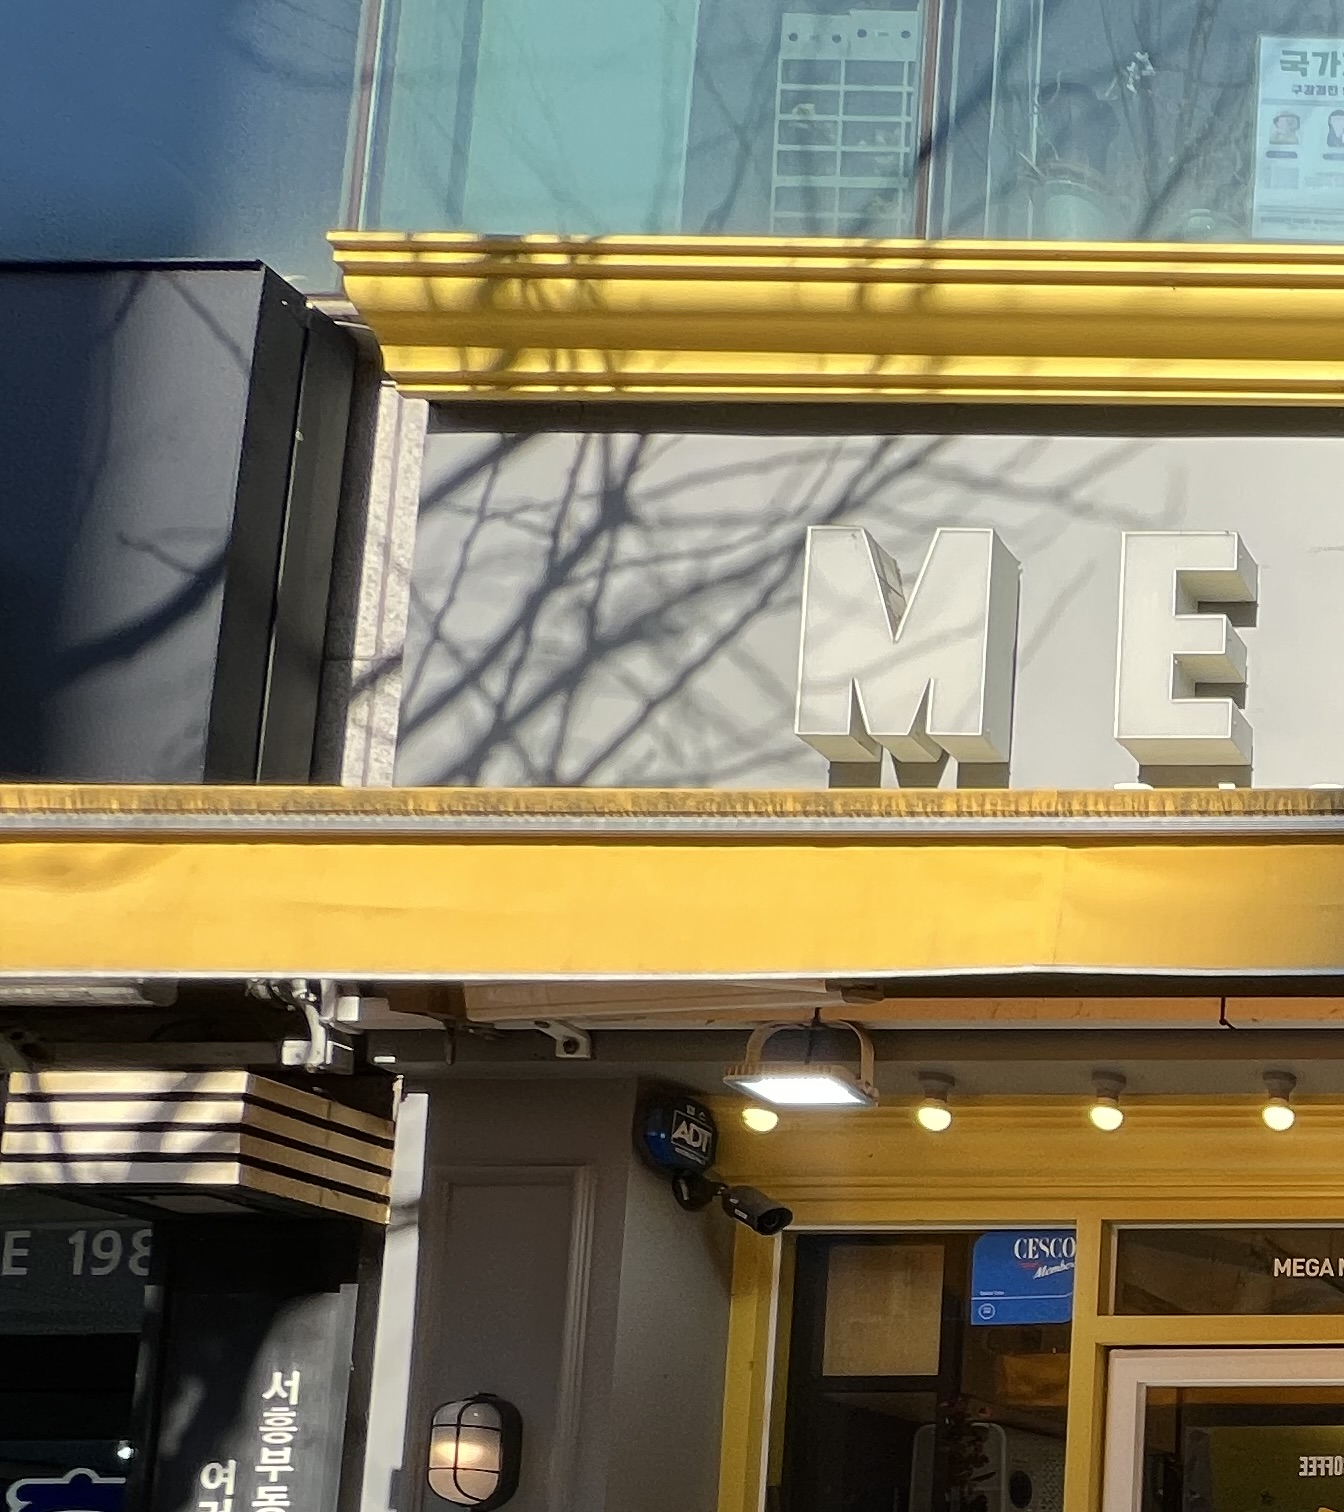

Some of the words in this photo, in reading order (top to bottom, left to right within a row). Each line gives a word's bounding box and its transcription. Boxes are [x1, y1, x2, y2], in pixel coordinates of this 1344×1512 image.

[671, 1120, 713, 1153] ADT
[1013, 1236, 1076, 1260] CESCO
[1273, 1257, 1335, 1278] MEGA
